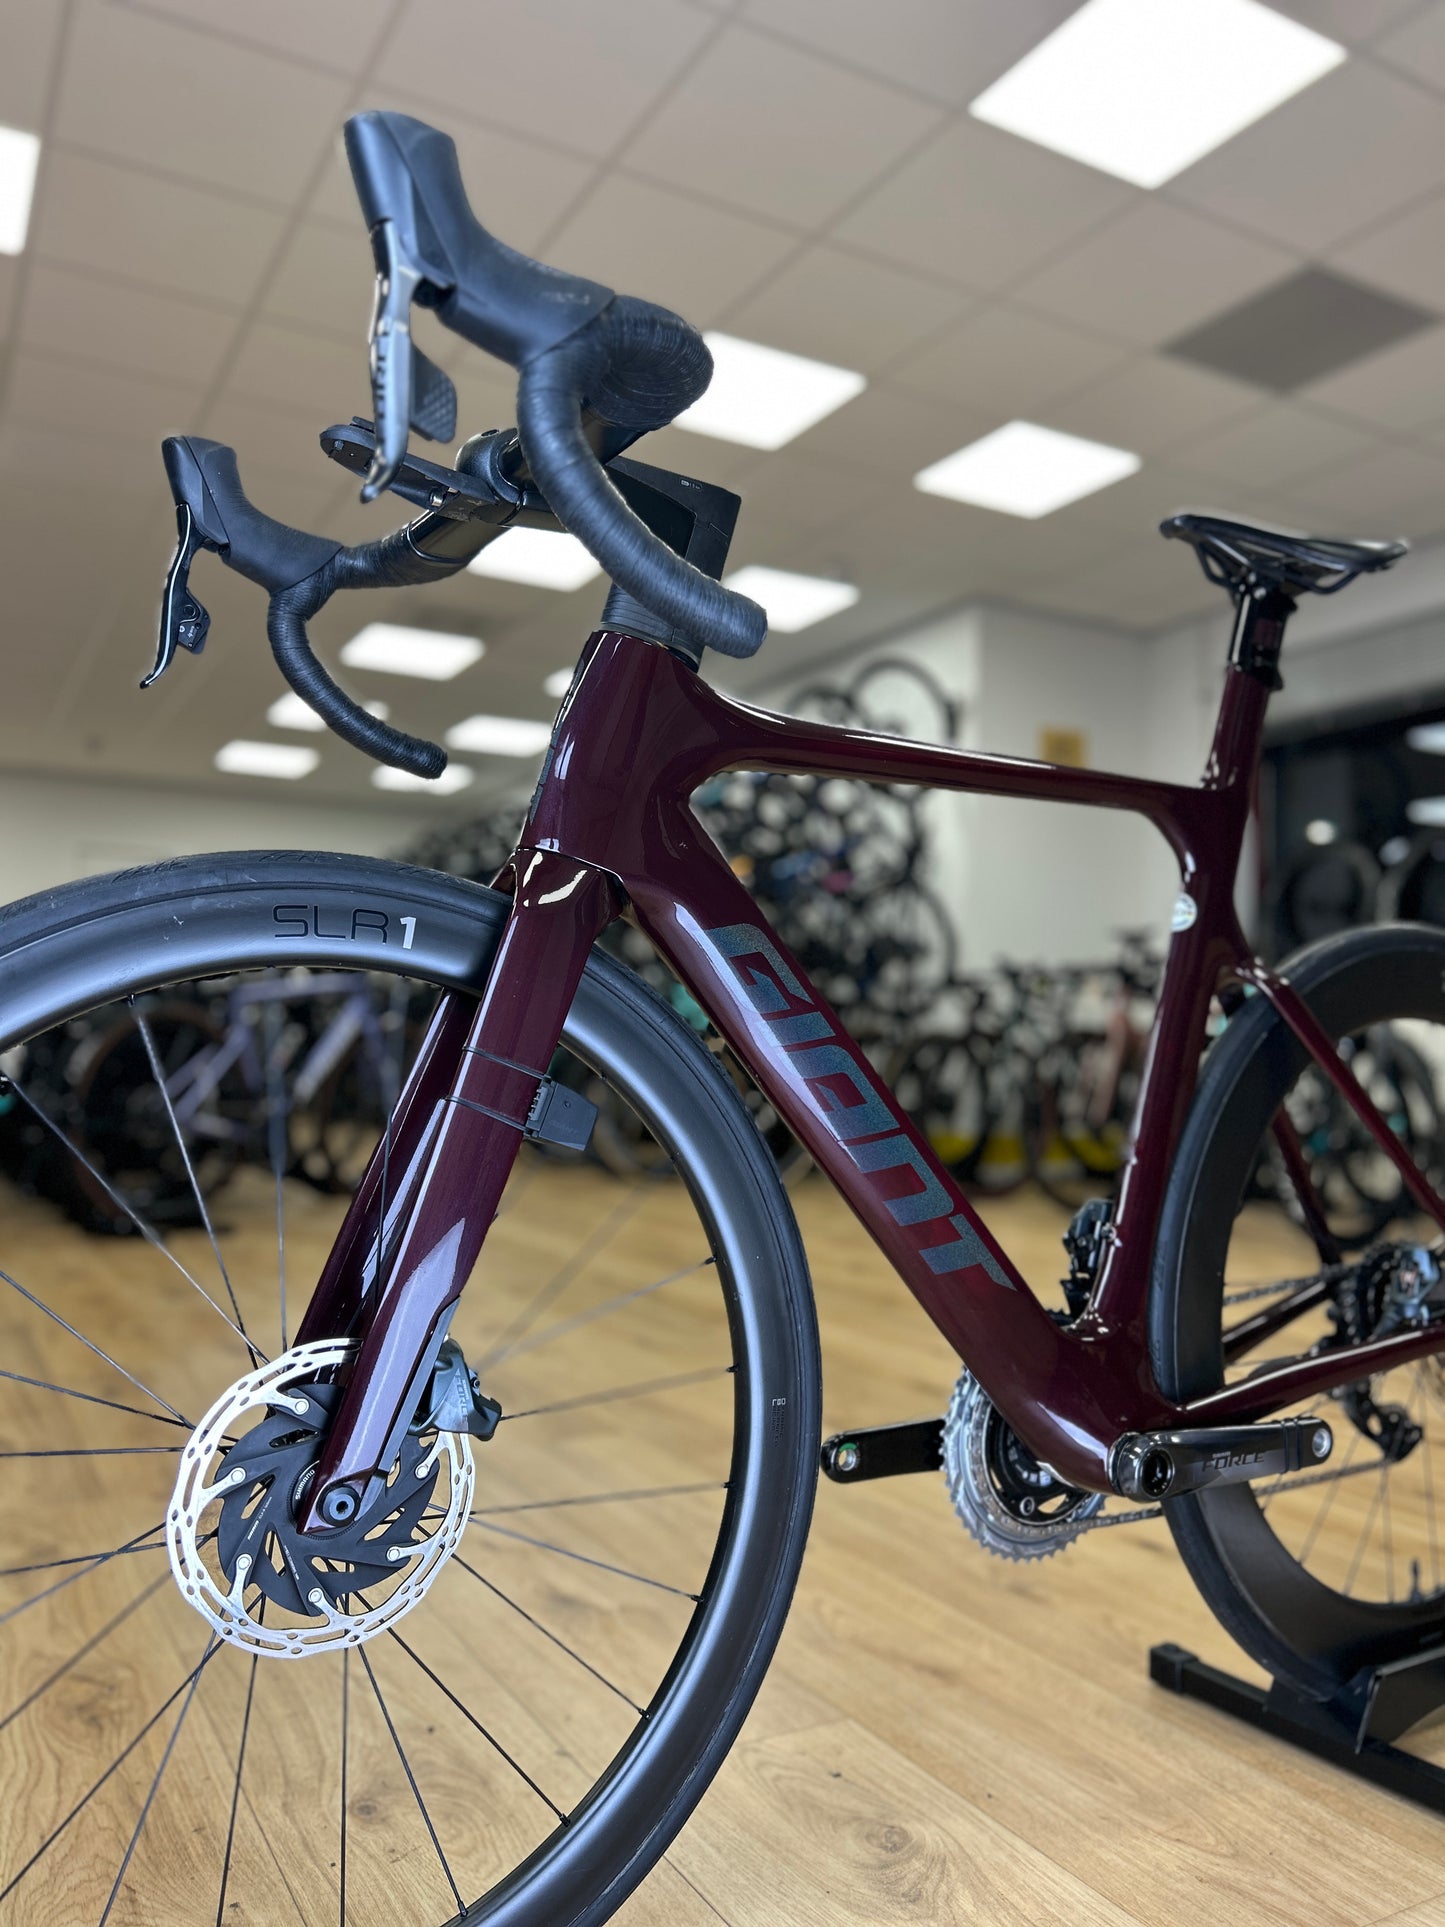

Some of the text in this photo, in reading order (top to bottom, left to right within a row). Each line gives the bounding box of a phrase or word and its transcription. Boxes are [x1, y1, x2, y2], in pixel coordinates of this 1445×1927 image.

[273, 904, 417, 949] SLR 1
[692, 923, 1018, 1292] GIANT
[1202, 1452, 1265, 1472] FORCE
